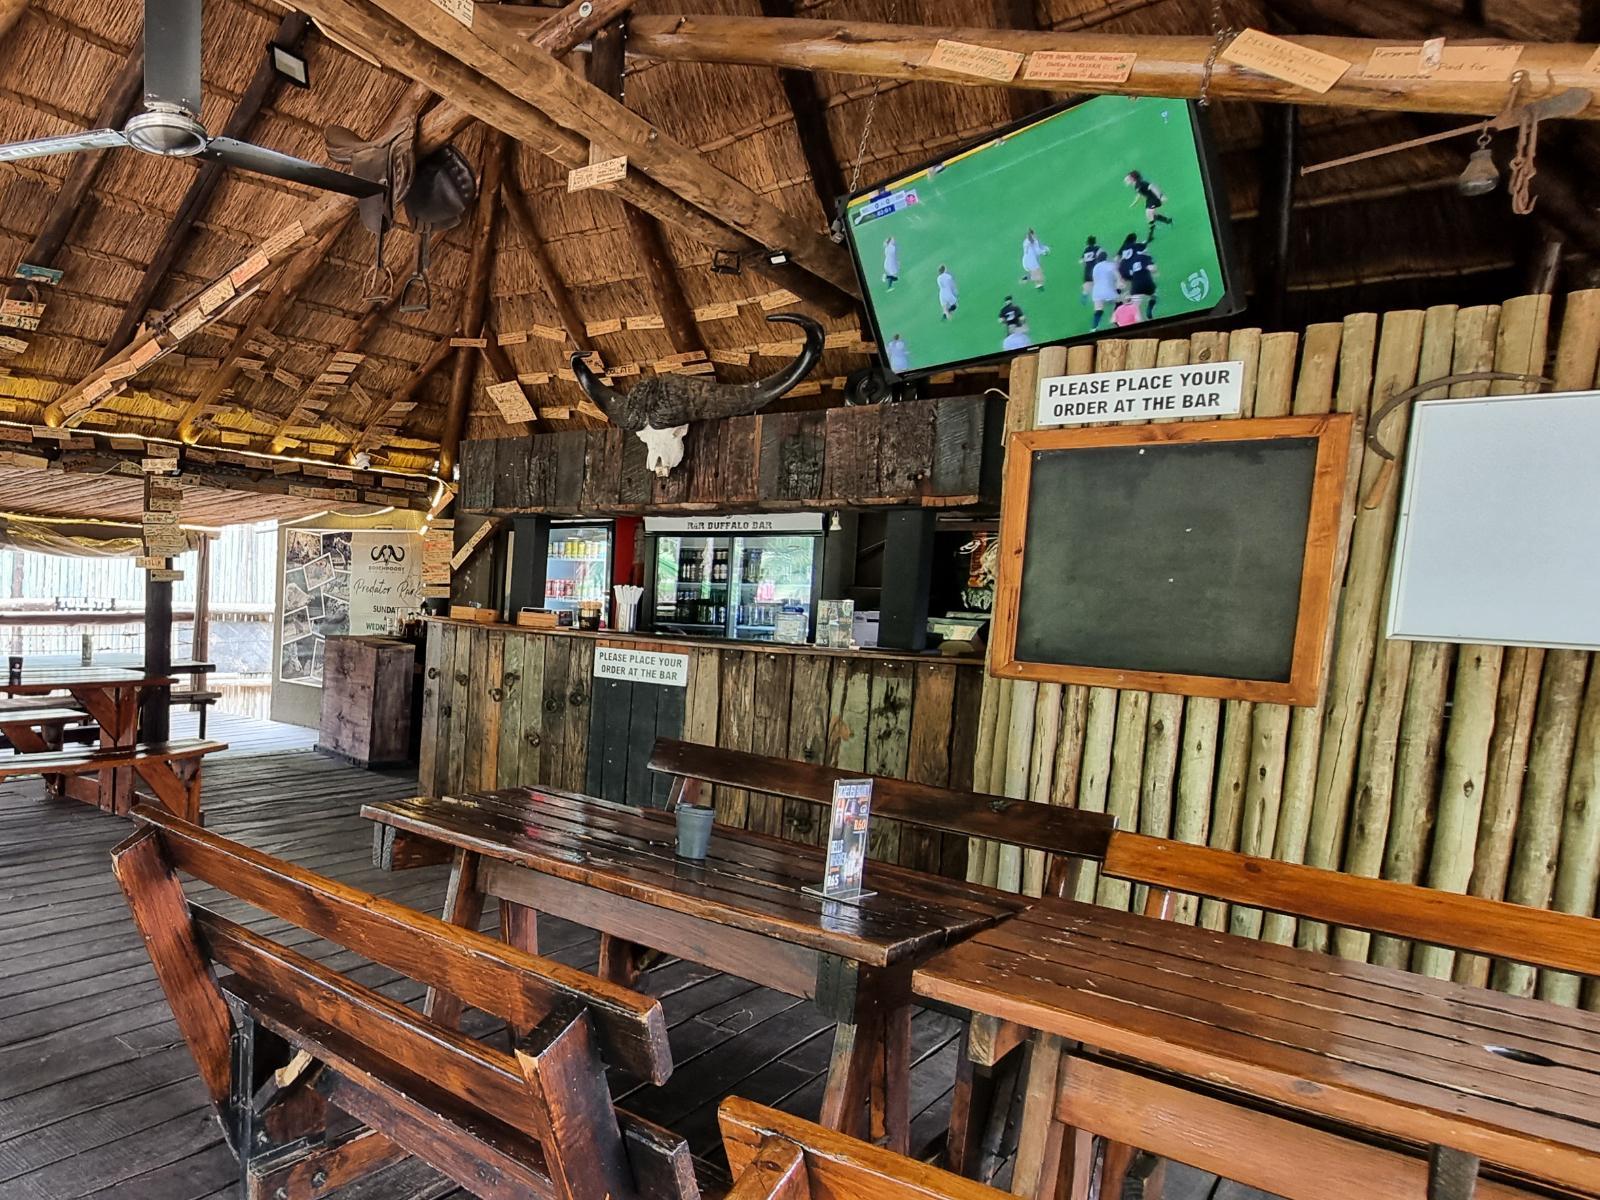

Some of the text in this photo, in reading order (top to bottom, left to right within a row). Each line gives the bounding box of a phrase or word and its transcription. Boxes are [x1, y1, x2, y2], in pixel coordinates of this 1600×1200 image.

[1049, 369, 1230, 397] PLEASE PLACE YOUR
[1053, 392, 1221, 417] ORDER AT THE BAR
[707, 521, 749, 530] BUFFALO
[751, 521, 773, 530] BAR
[354, 578, 392, 596] Predator
[366, 622, 387, 631] WEDN
[599, 652, 682, 668] PLEASE PLACE YOUR
[601, 664, 678, 680] ORDER AT THE BAR
